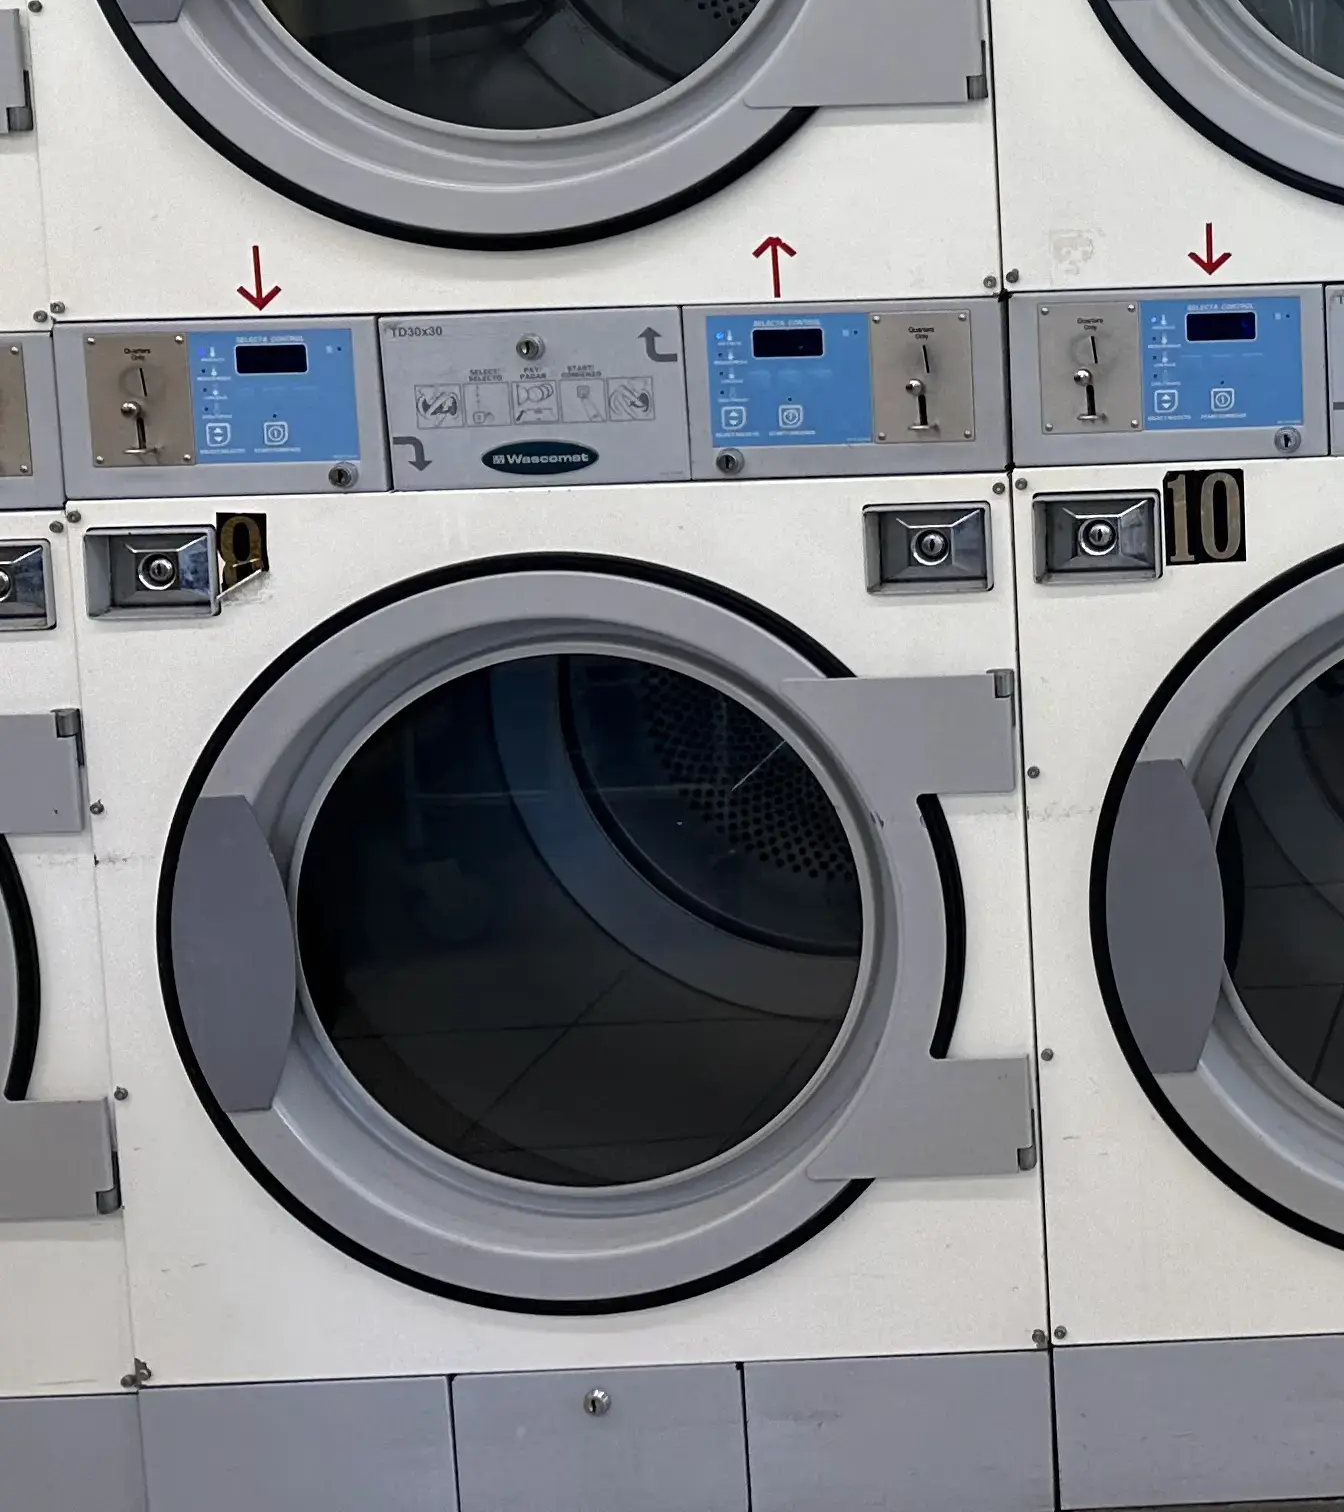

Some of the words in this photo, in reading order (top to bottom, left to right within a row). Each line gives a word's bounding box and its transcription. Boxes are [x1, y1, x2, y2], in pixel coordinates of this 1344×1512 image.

[391, 326, 443, 337] TD30x30
[506, 452, 589, 465] Wascomat
[1166, 471, 1242, 563] 10
